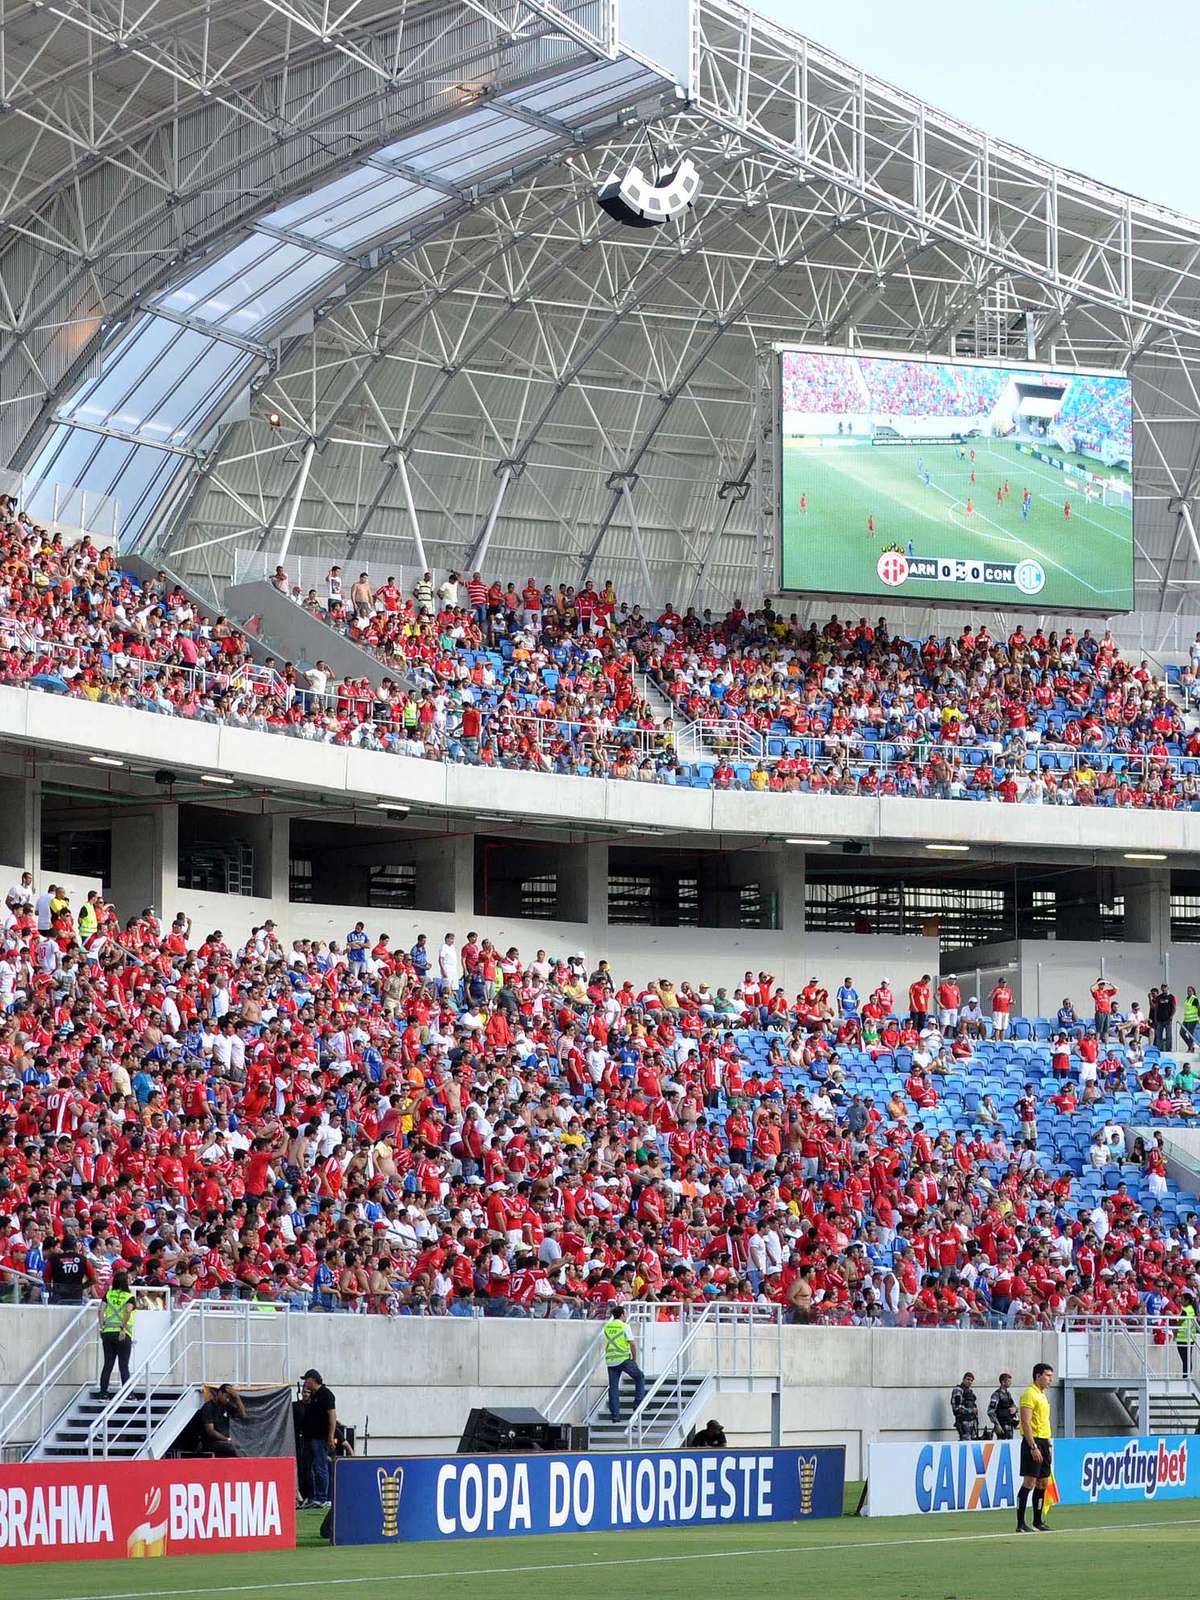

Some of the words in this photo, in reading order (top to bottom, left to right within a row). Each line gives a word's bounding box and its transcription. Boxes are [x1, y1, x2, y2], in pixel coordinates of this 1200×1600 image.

[909, 562, 936, 576] ARN
[942, 565, 951, 577] 0
[971, 568, 980, 579] 0
[985, 569, 1012, 582] CON
[48, 1093, 61, 1111] 10
[62, 1263, 79, 1274] 170
[436, 1462, 532, 1535] COPA
[549, 1459, 596, 1528] DO
[610, 1456, 774, 1525] NORDESTE
[915, 1442, 1015, 1513] CAIXA
[1083, 1441, 1187, 1498] sportingbet
[169, 1481, 282, 1540] BRAHMA
